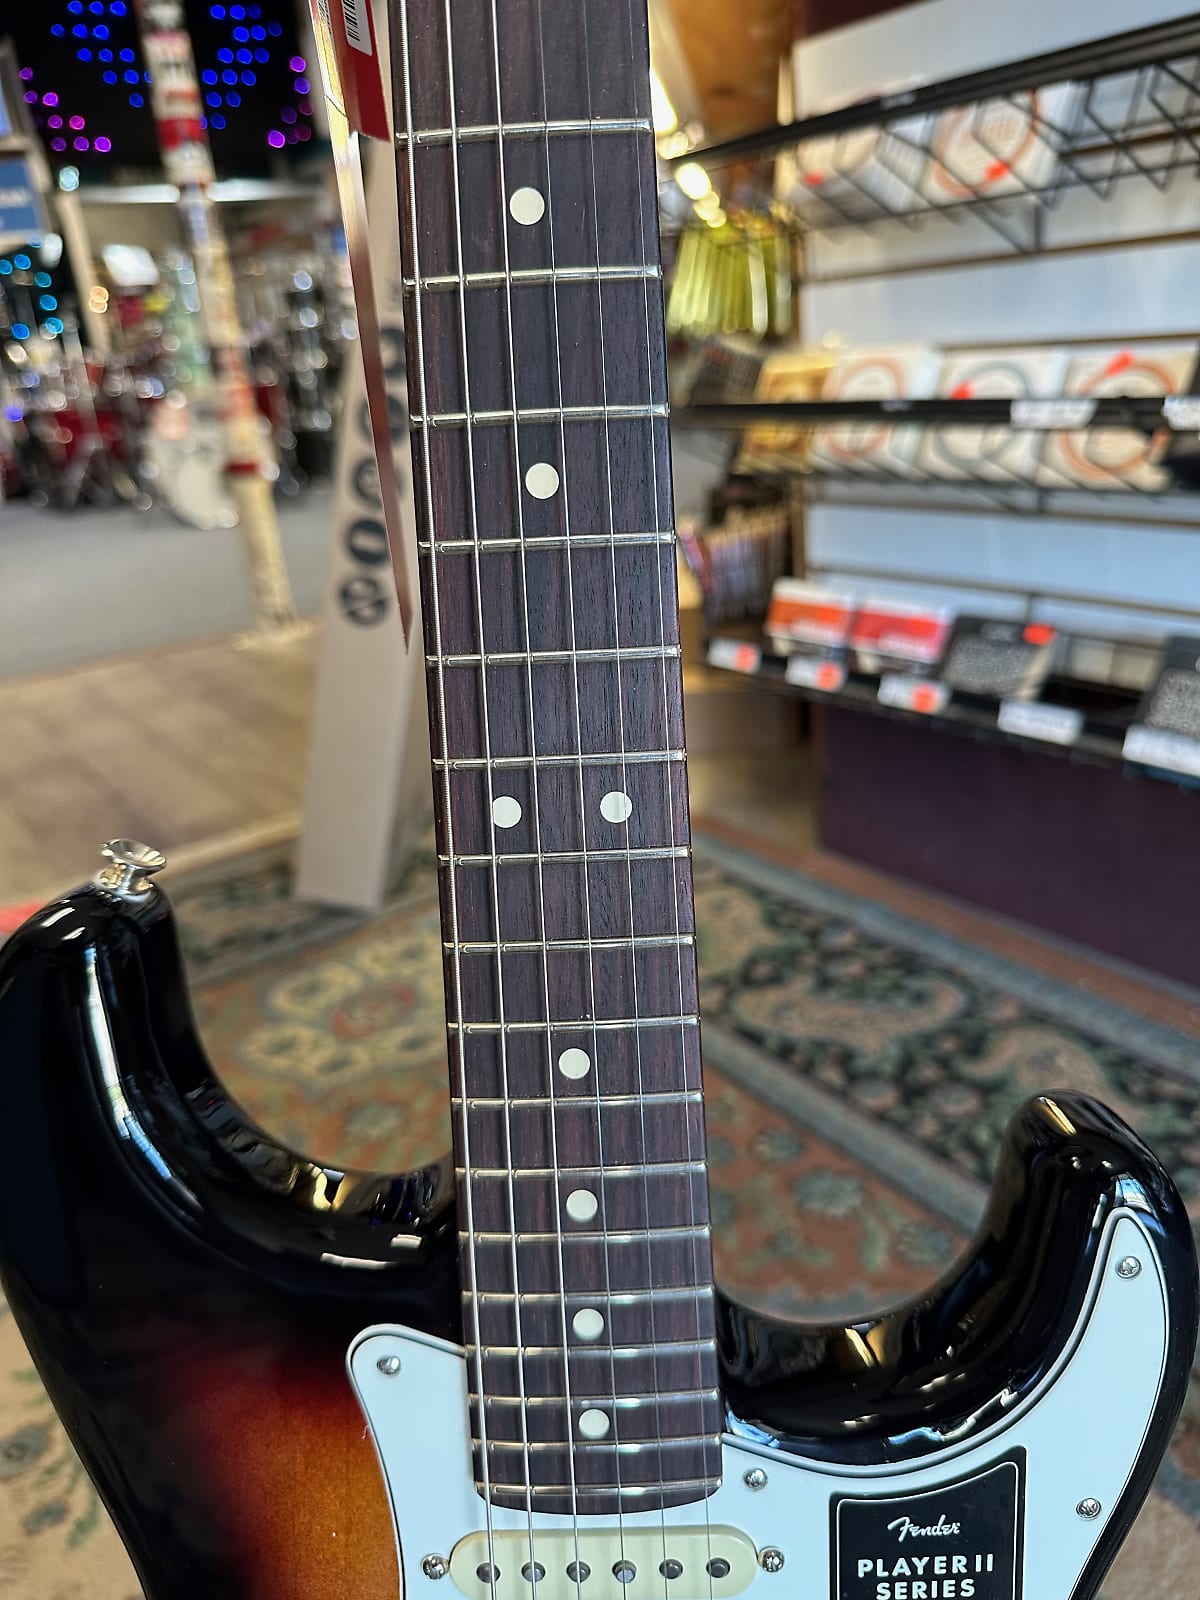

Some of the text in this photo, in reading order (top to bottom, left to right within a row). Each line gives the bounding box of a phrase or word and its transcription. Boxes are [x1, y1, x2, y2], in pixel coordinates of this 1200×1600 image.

[887, 1514, 960, 1543] Fender
[857, 1553, 994, 1578] PLAYER II
[876, 1578, 976, 1600] SERIES
